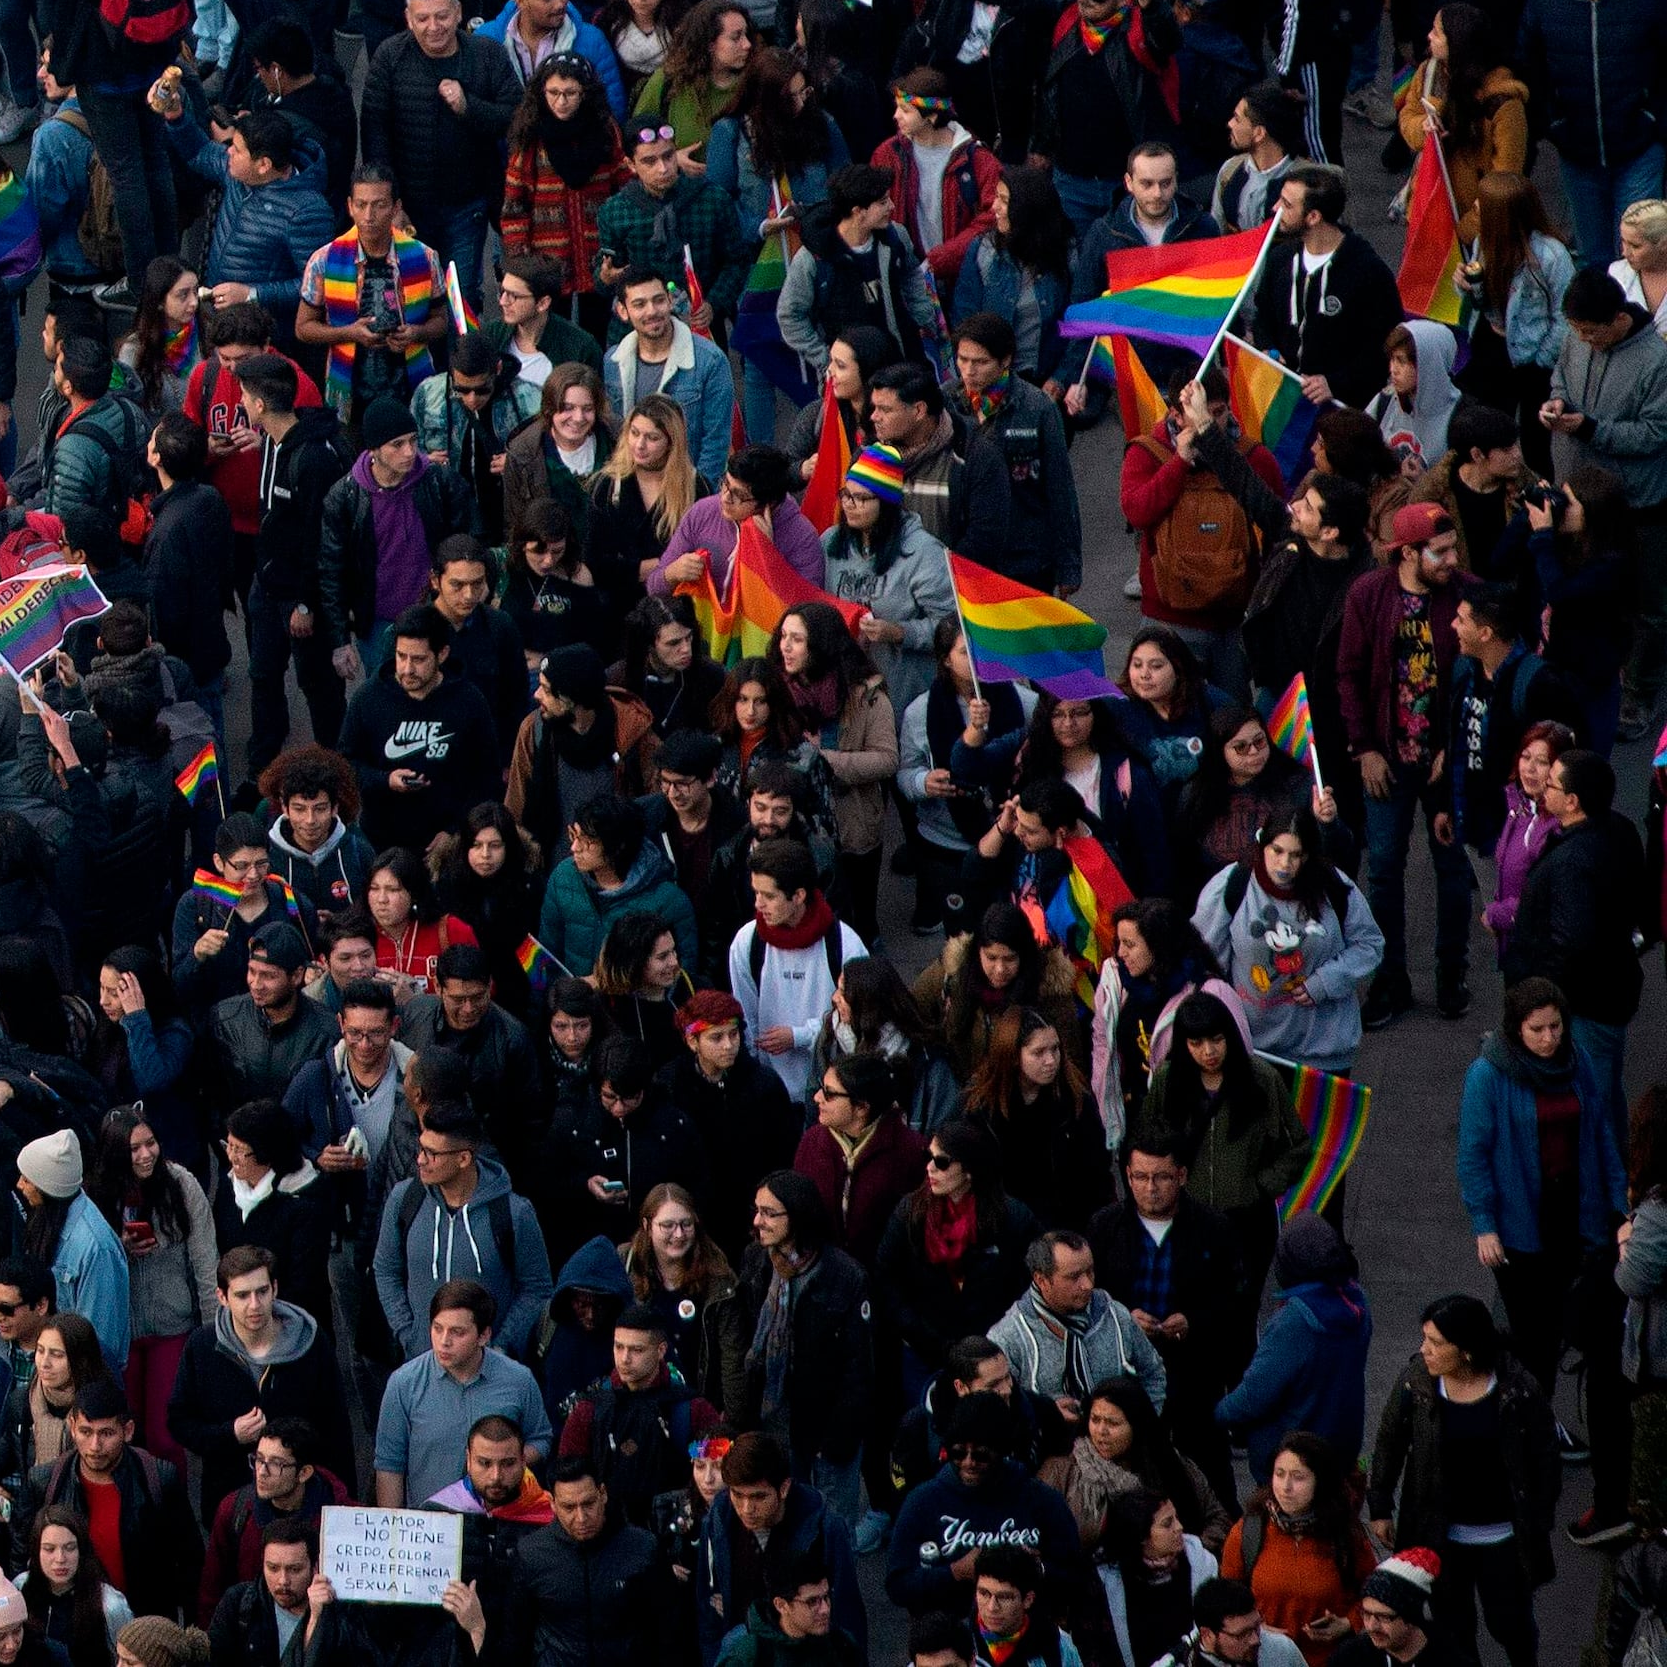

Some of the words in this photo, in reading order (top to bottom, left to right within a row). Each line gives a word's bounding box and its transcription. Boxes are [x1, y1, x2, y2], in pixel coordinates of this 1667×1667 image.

[396, 721, 443, 742] NIKE
[426, 743, 450, 759] SB
[354, 1512, 375, 1526] EL
[380, 1515, 425, 1529] AMOR
[364, 1528, 390, 1542] NO
[398, 1529, 445, 1544] TIENE
[940, 1514, 1041, 1556] Yankees
[388, 1547, 431, 1561] COLOR
[360, 1562, 451, 1578] PREFERENCIA
[344, 1577, 413, 1595] SEXUAL
